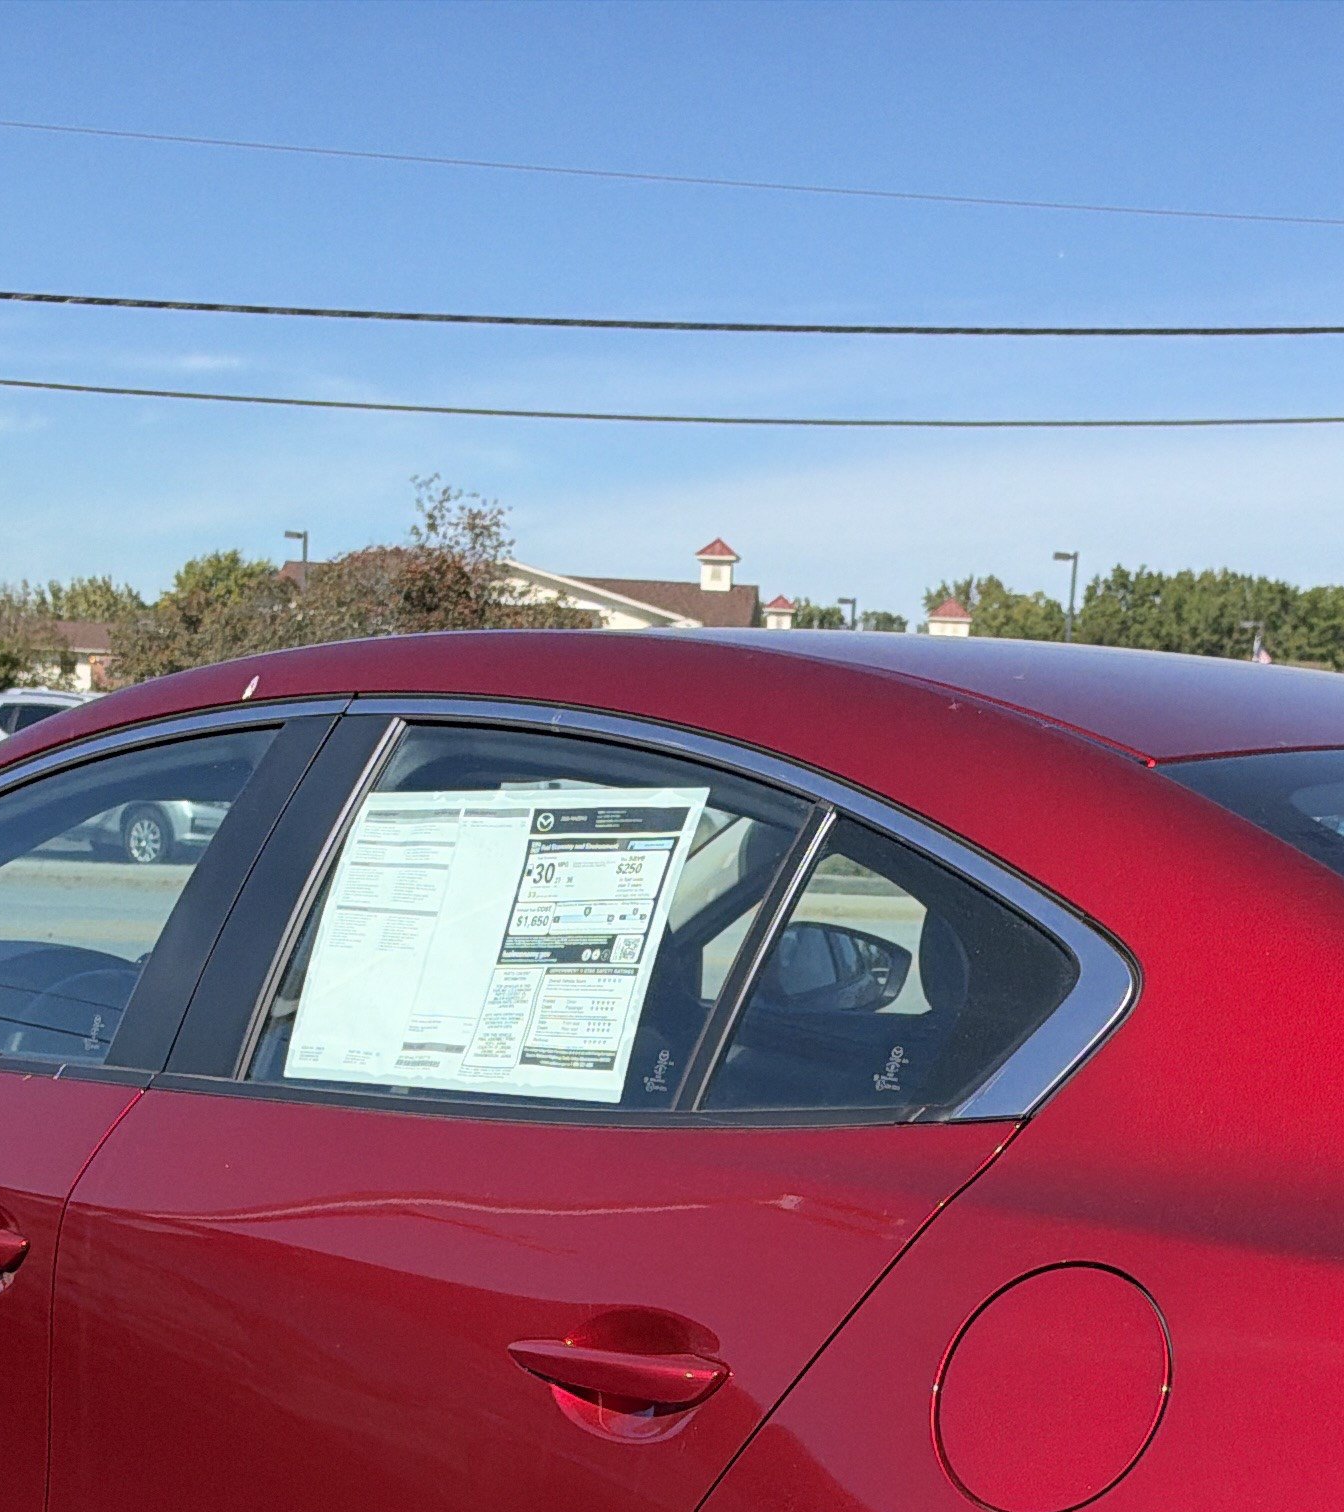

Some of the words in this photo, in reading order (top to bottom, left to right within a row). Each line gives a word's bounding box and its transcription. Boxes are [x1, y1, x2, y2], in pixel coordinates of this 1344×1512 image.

[533, 862, 556, 884] 30
[616, 862, 643, 875] $250
[516, 914, 550, 928] $1,650
